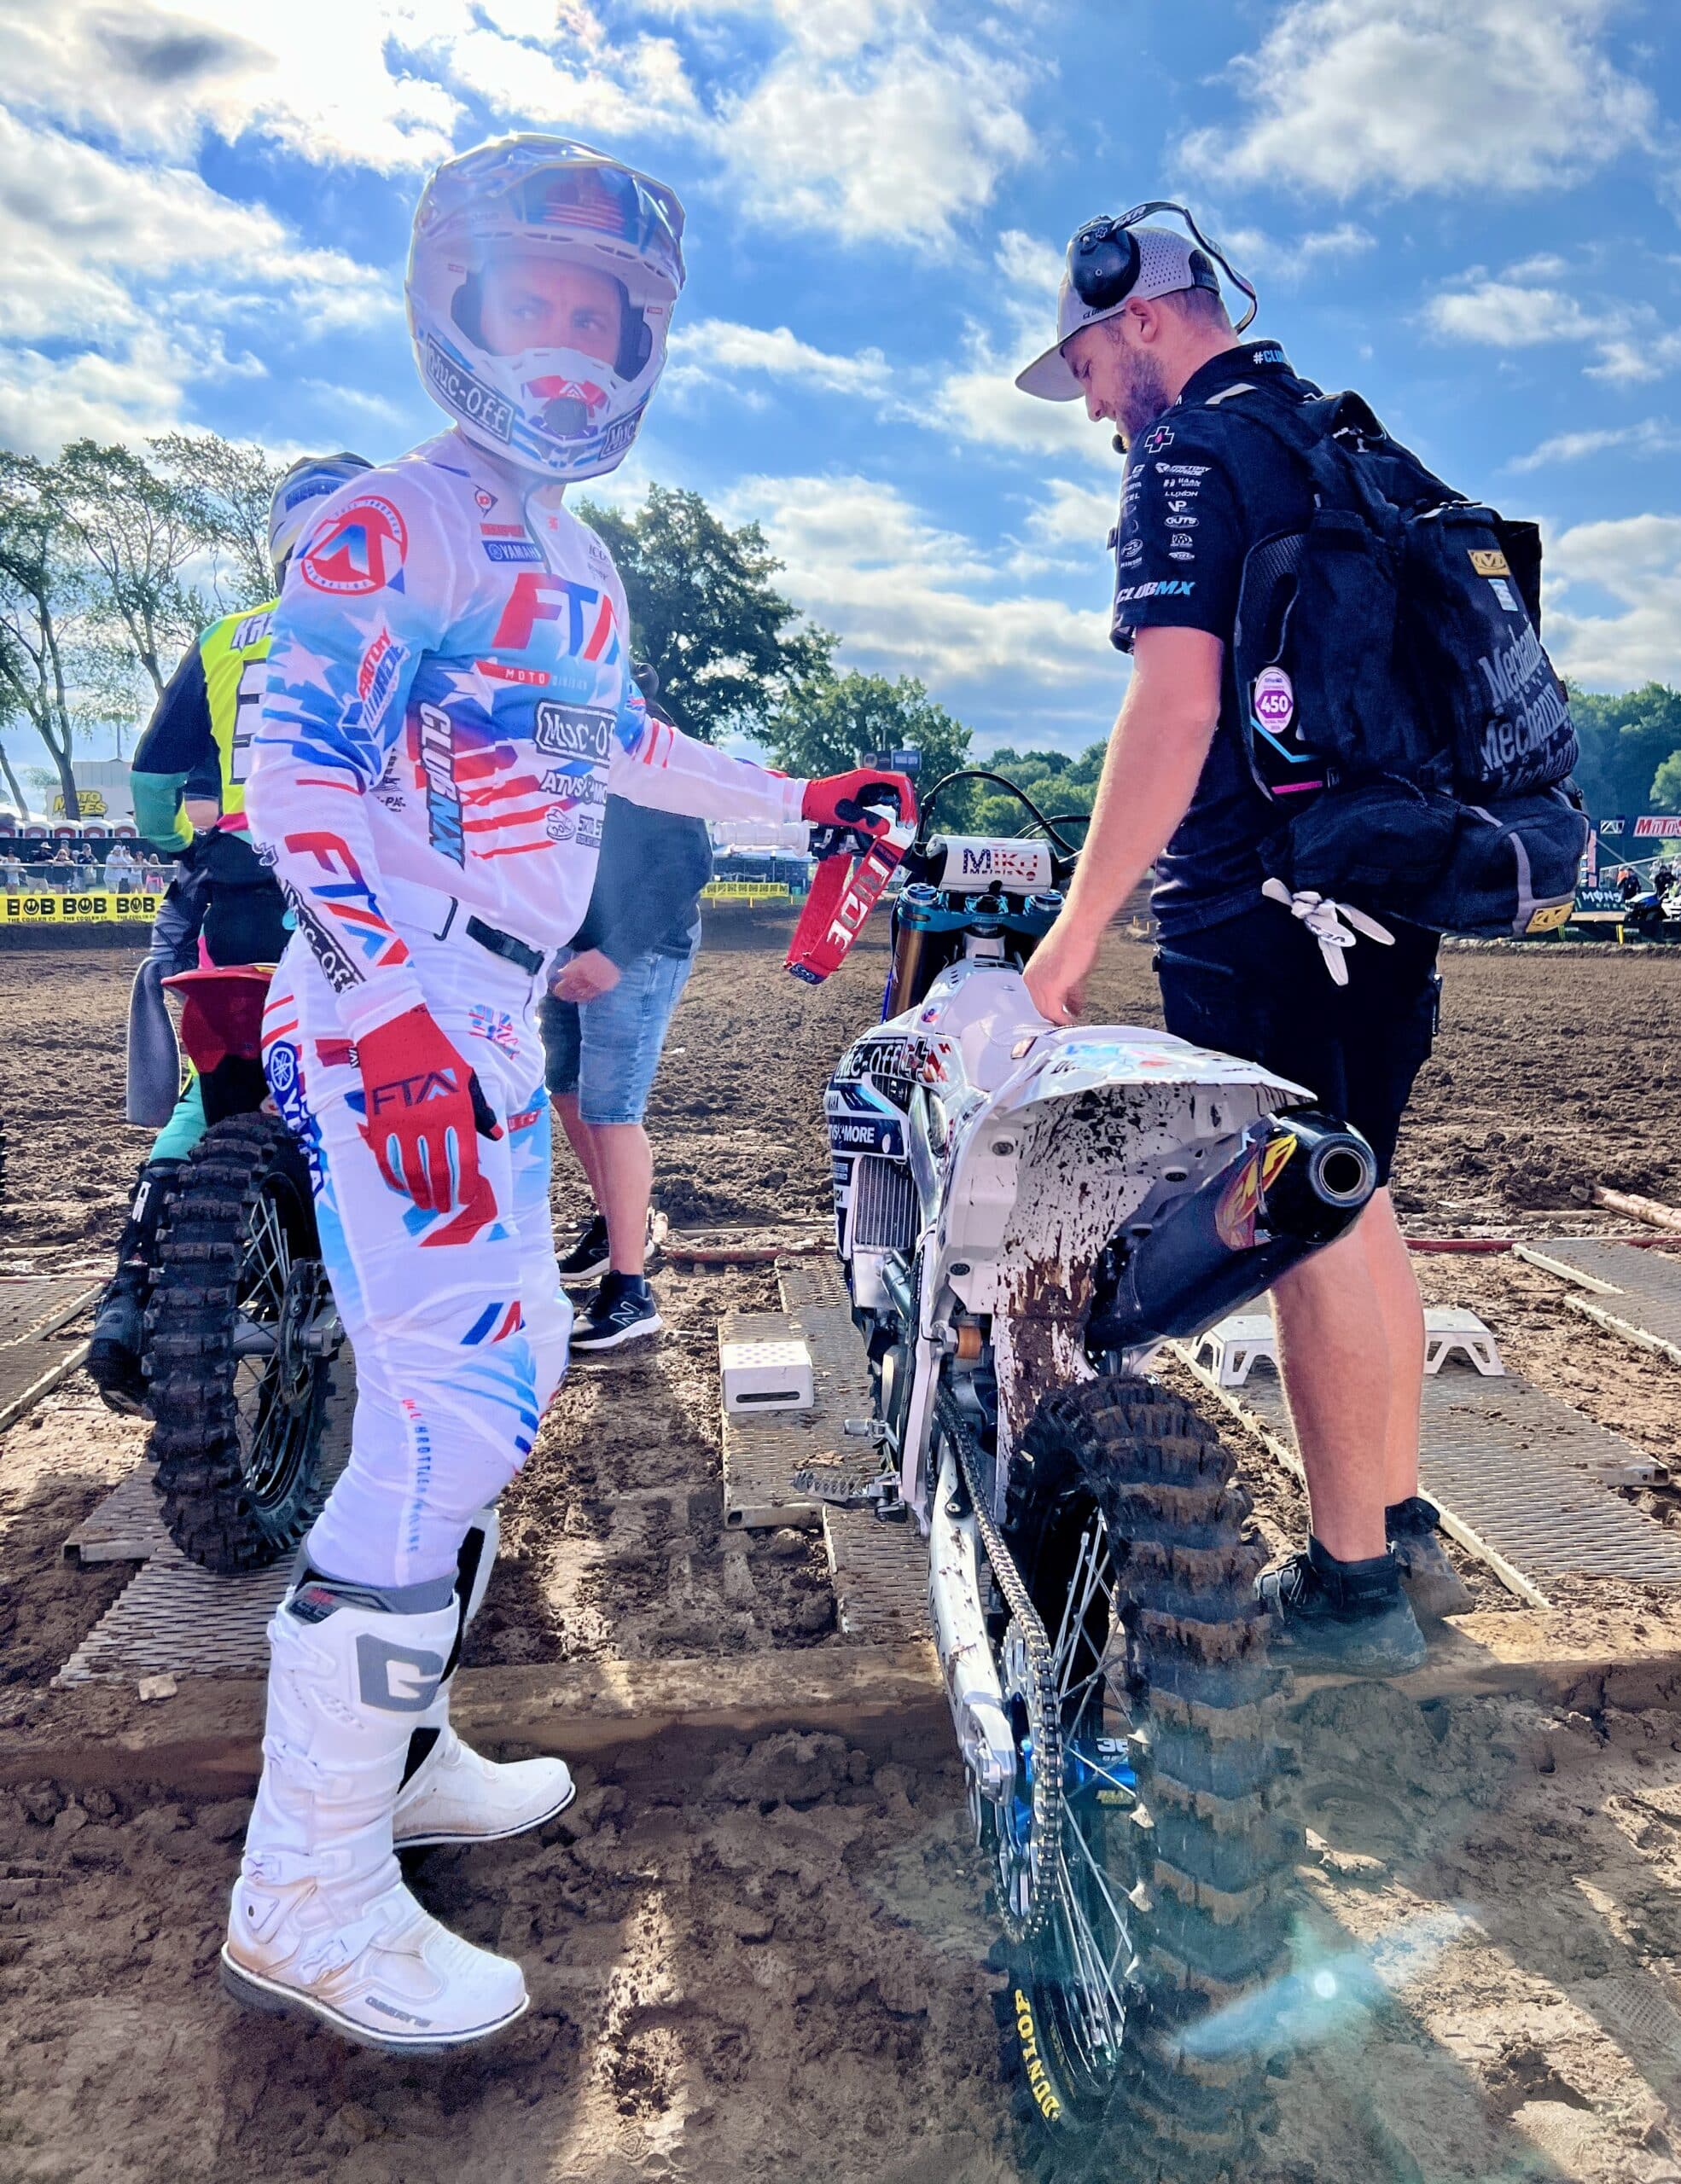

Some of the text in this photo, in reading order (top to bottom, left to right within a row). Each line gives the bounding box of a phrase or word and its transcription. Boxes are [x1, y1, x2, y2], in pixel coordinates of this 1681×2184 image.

[1166, 516, 1197, 525] GUTS
[1116, 581, 1195, 604] CLUBMX
[505, 669, 545, 684] MOTO
[1260, 694, 1288, 713] 450
[62, 897, 108, 914] BOB
[116, 897, 155, 914] BOB
[371, 1068, 460, 1115] FTA
[1014, 1989, 1060, 2118] DUNLOP
